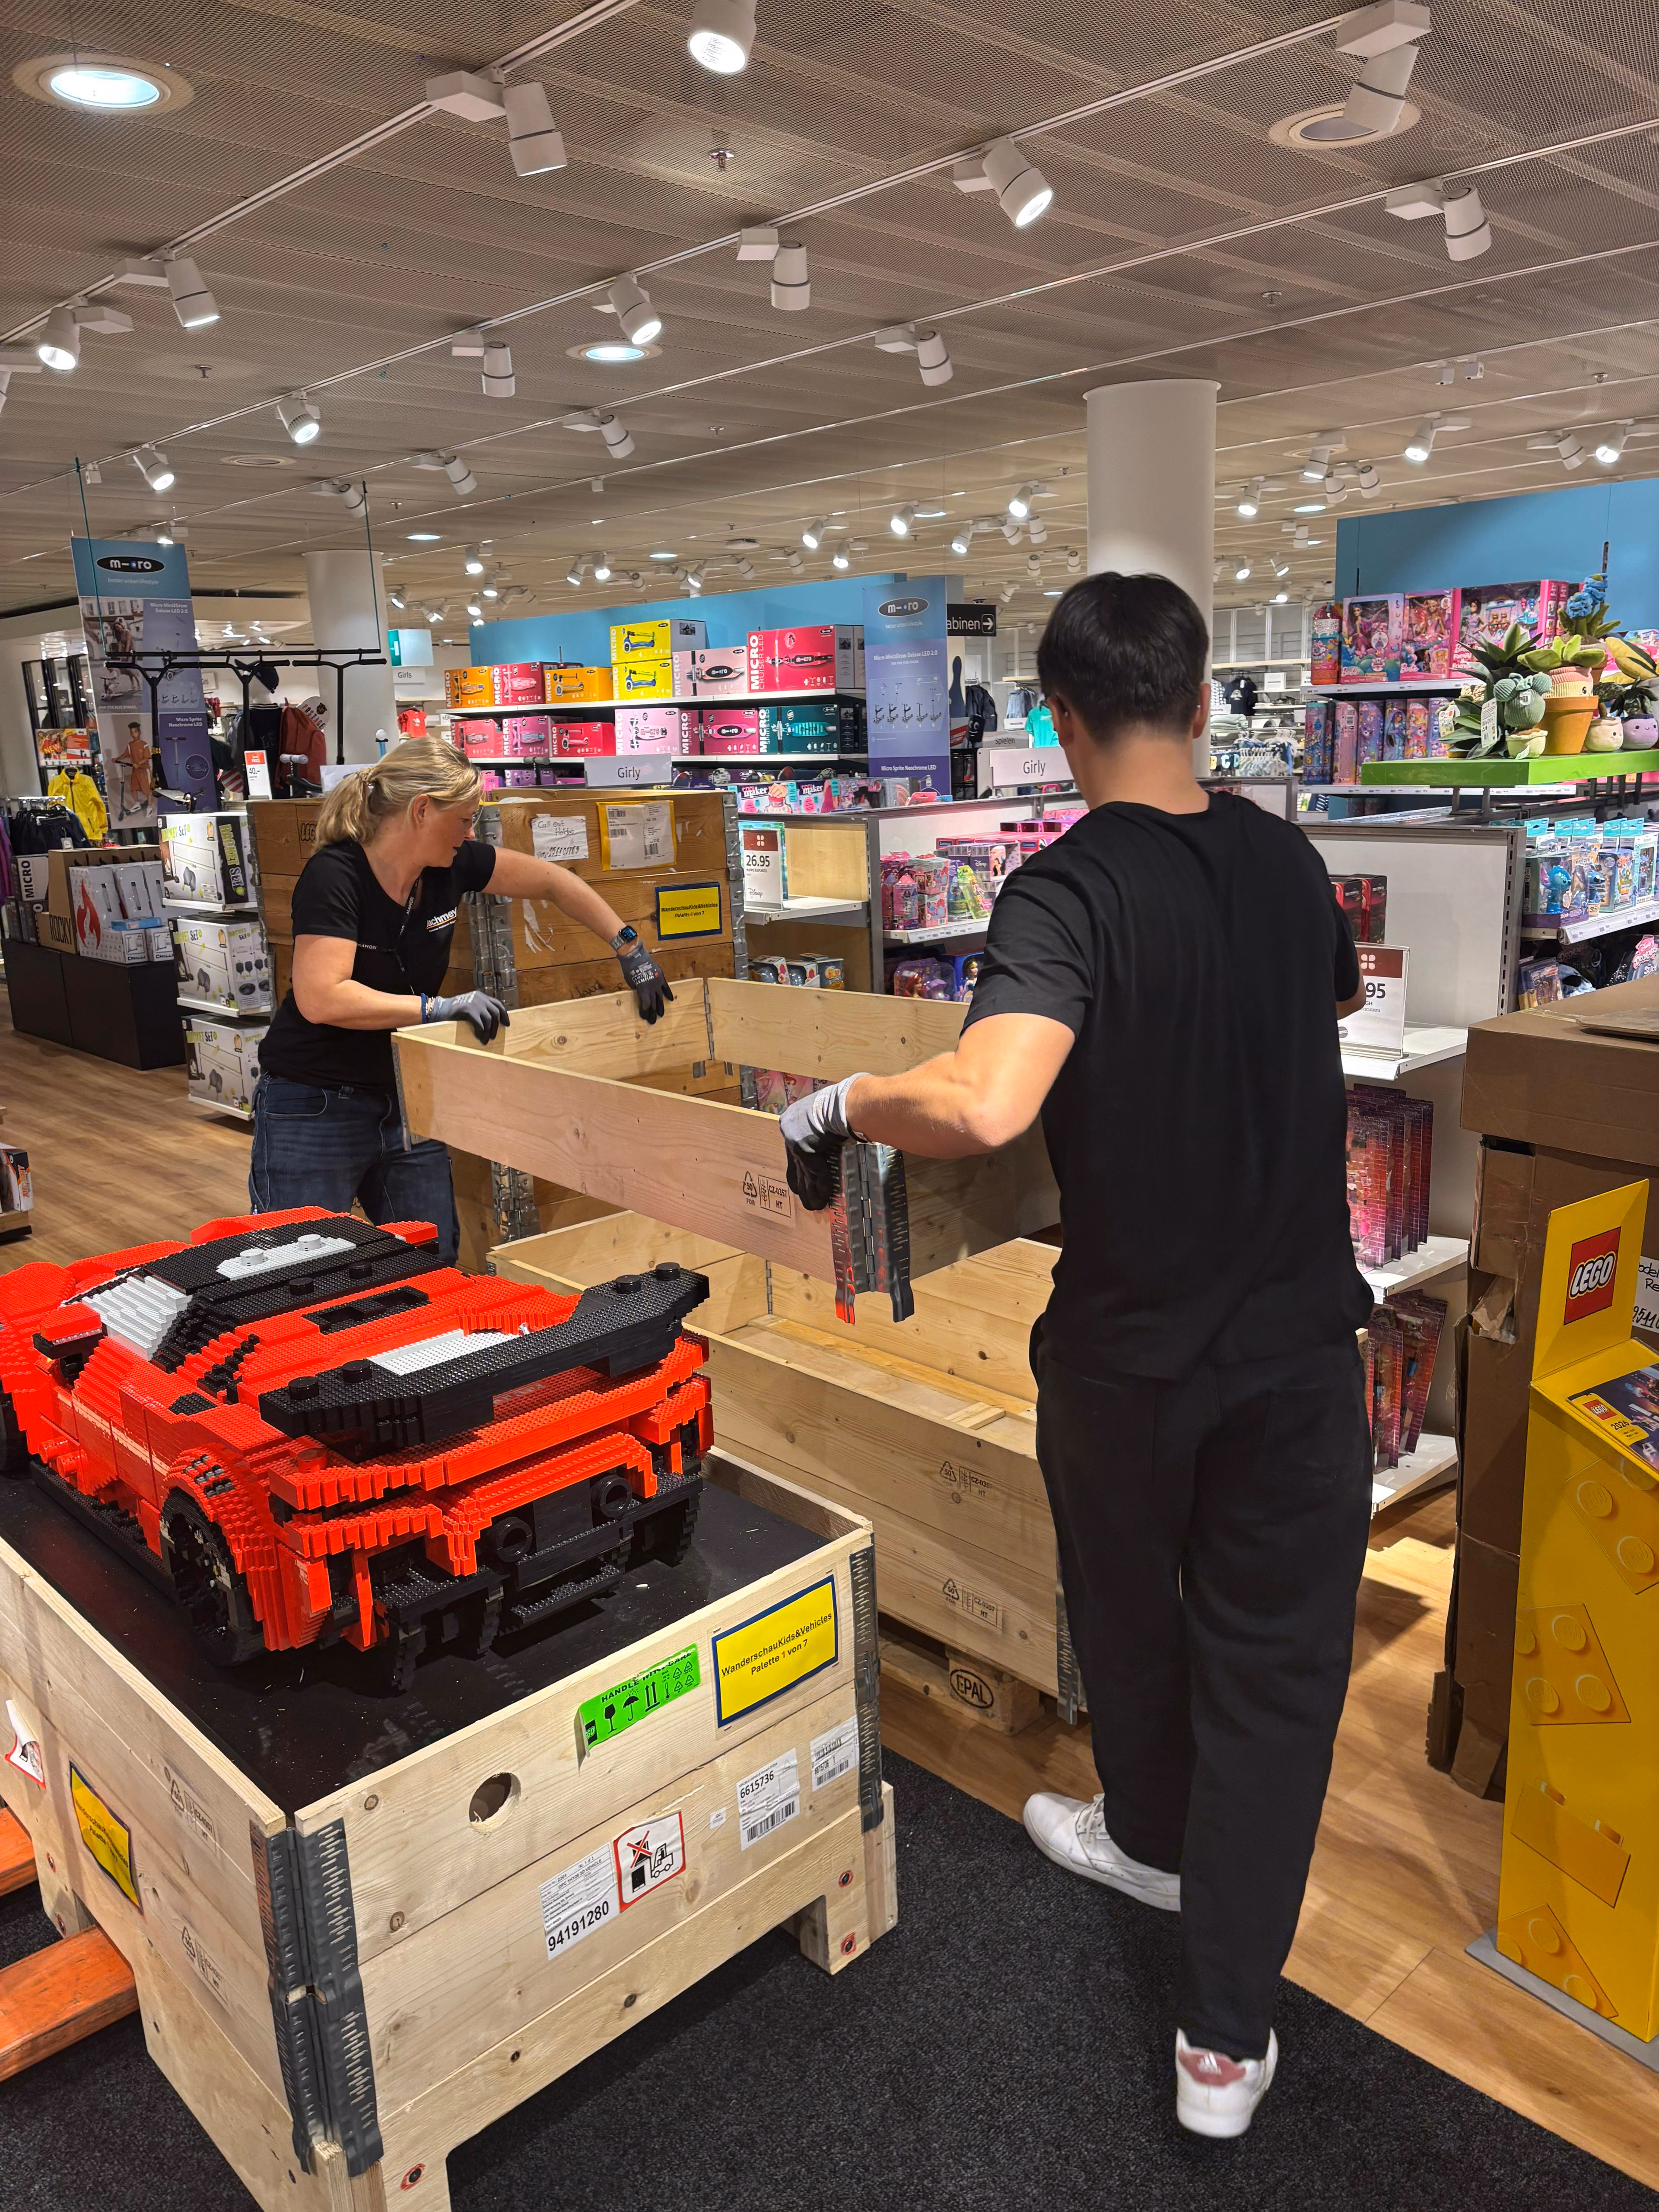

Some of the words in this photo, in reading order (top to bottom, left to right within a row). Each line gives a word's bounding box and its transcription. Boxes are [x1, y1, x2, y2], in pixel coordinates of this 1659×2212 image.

[750, 635, 760, 690] MICRO
[1400, 663, 1419, 674] Barbie
[673, 654, 681, 696] MICRO
[1341, 667, 1360, 677] Barbie
[493, 667, 502, 705] MICRO
[302, 704, 326, 730] POSTAGE
[681, 712, 689, 754] MICRO
[758, 709, 767, 753] MICRO
[44, 743, 60, 754] NEW
[617, 766, 641, 781] Girly
[1023, 760, 1046, 775] Girly
[744, 787, 769, 798] maker
[802, 785, 824, 795] maker
[219, 823, 240, 866] RACKET
[746, 855, 770, 867] 26.95
[975, 860, 987, 868] Disney
[23, 860, 35, 899] MICRO
[229, 867, 244, 887] SET
[747, 887, 763, 898] Disney
[48, 914, 73, 945] ROCKY
[190, 928, 199, 941] SET
[1365, 982, 1386, 999] 95
[204, 1031, 214, 1042] SET
[747, 1182, 753, 1191] 50
[775, 1200, 782, 1210] HT
[1570, 1252, 1615, 1298] LEGO
[1592, 1404, 1608, 1415] LEGO
[1610, 1420, 1630, 1431] 2026
[980, 1610, 988, 1618] HT
[721, 1613, 832, 1678] WanderschauKids&Vehicles
[751, 1654, 780, 1675] Palette
[788, 1643, 802, 1656] von
[803, 1639, 808, 1647] 7
[601, 1679, 640, 1703] HANDLE
[956, 1674, 988, 1705] EPAL
[740, 1770, 774, 1799] 6615736
[585, 1859, 602, 1872] VEHICLE
[548, 1901, 609, 1951] 94191280
